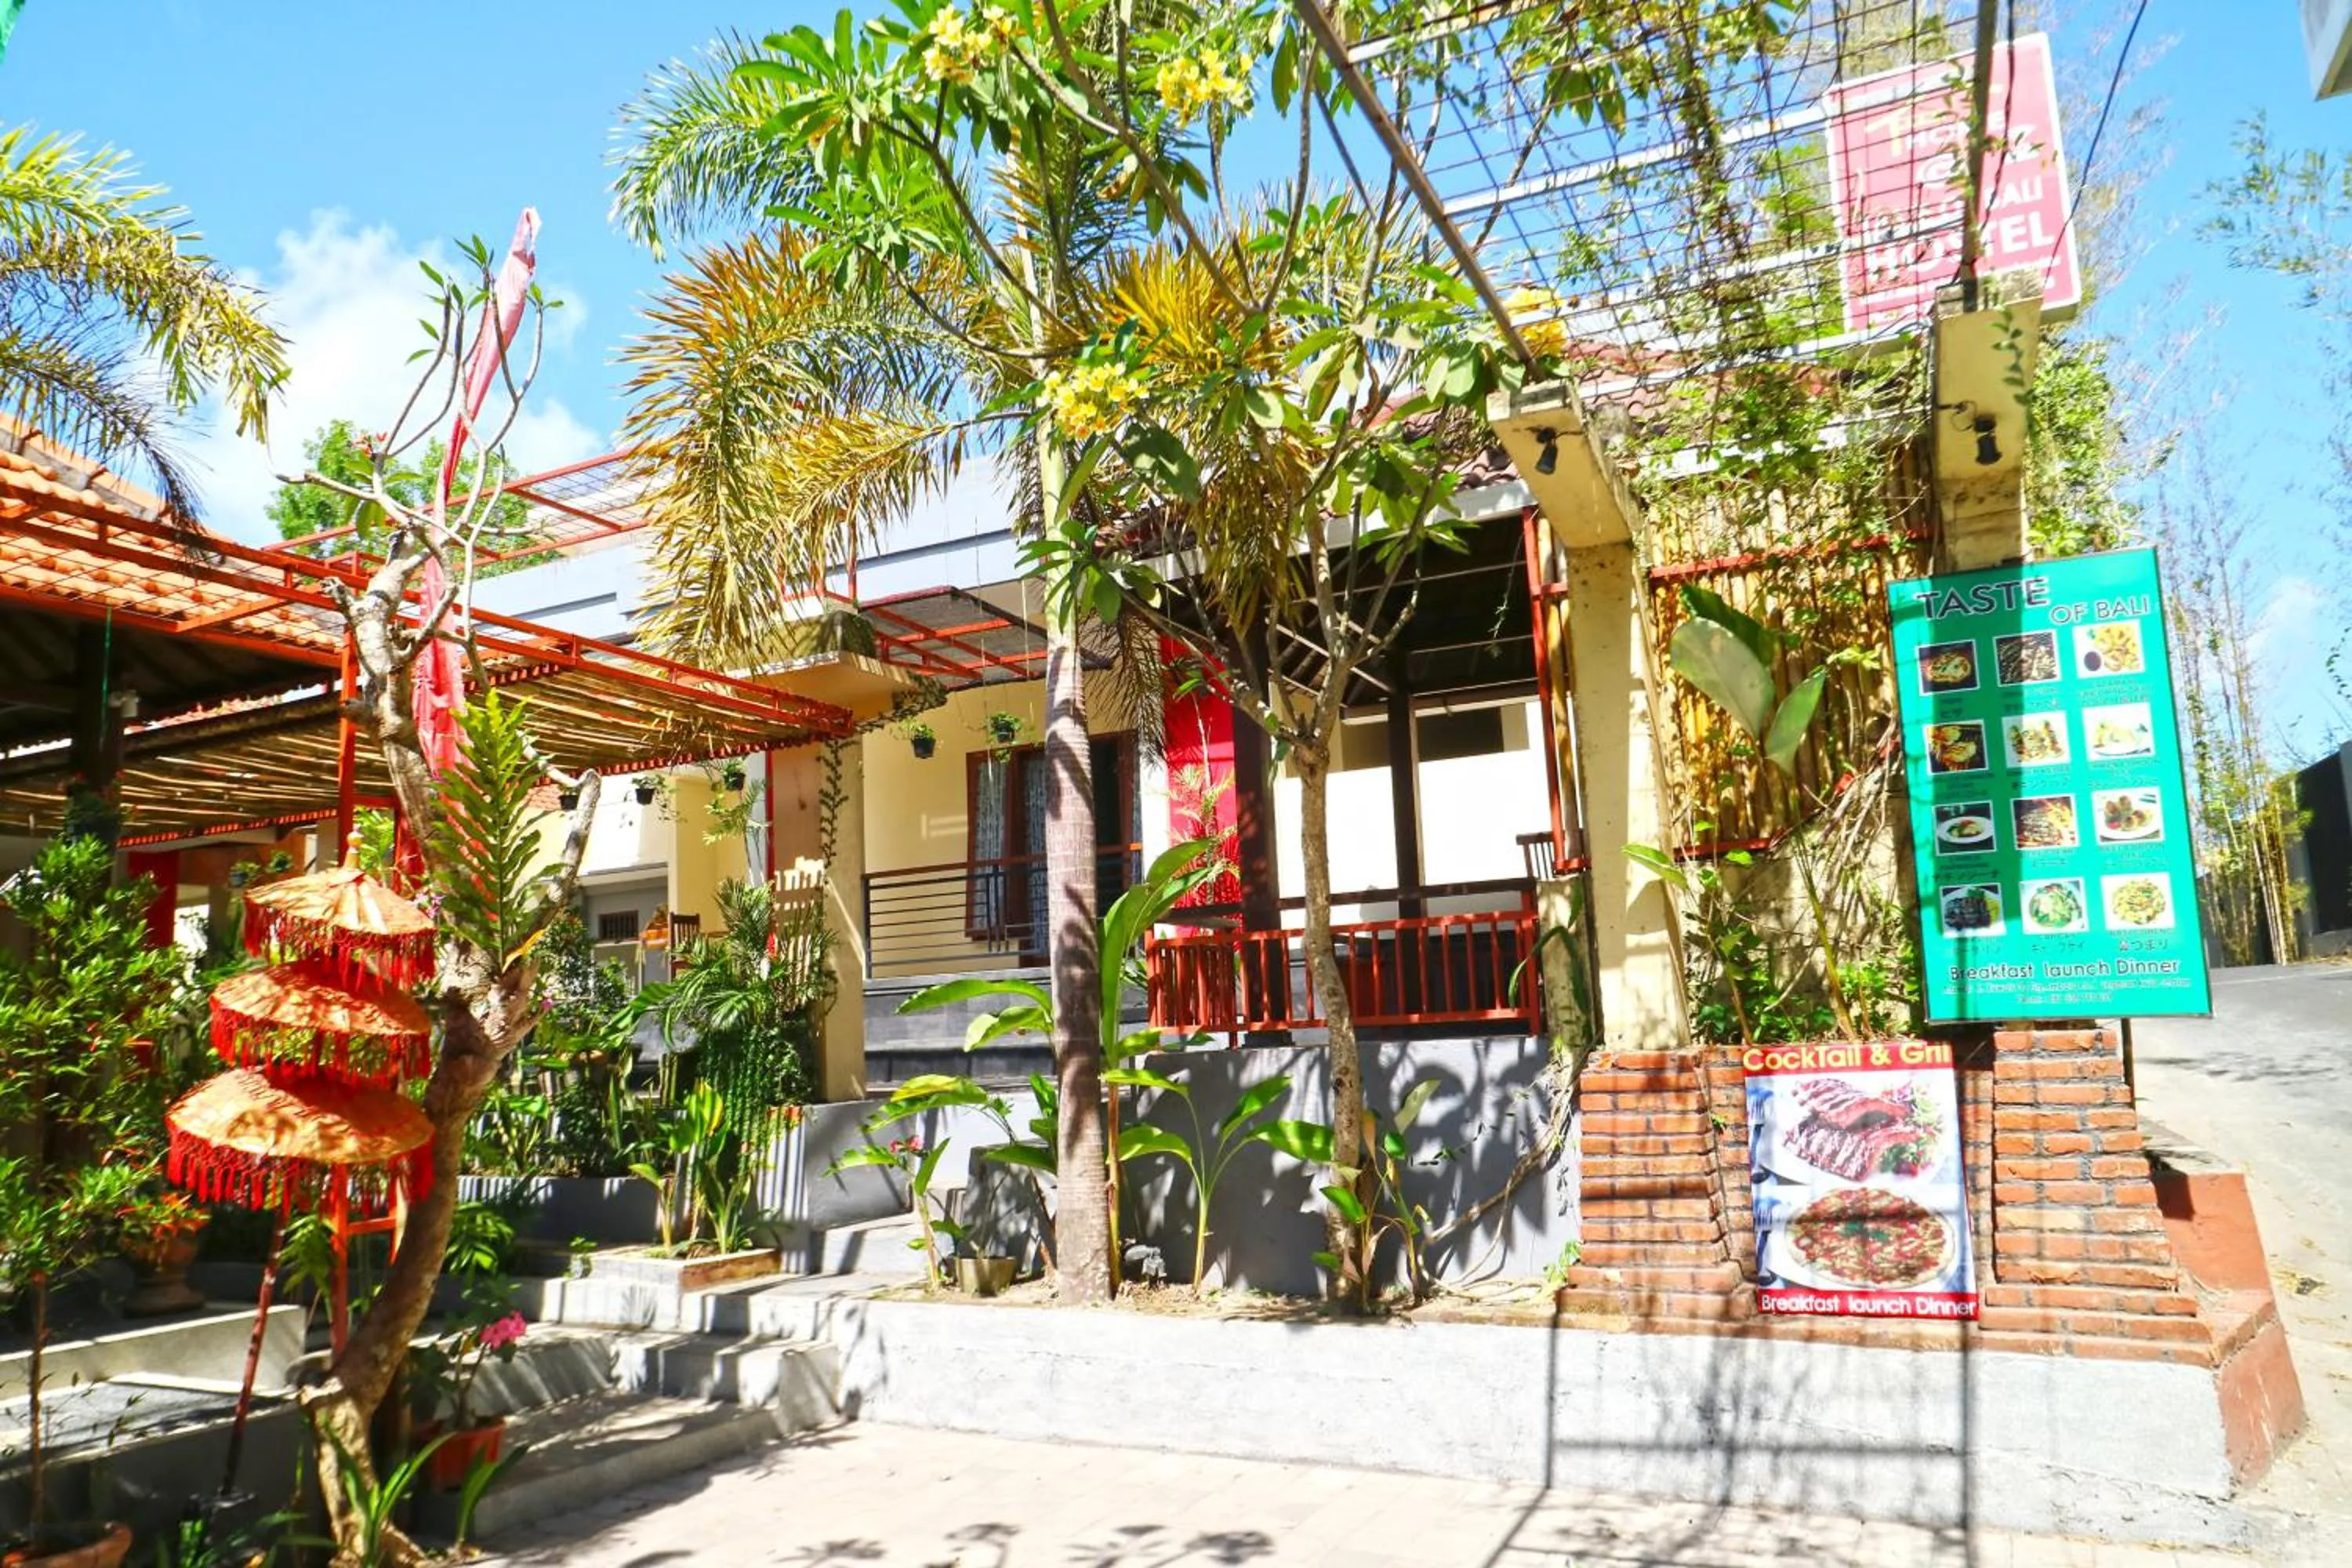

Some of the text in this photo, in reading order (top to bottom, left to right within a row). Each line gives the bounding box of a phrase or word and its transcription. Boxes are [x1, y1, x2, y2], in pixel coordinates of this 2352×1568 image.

[1915, 577, 2049, 620] TASTE
[2049, 596, 2150, 624] OF BALI
[1950, 958, 2180, 981] Breakfast launch Dinner
[1870, 1044, 1892, 1065] &
[1762, 1295, 1839, 1311] Breakfast
[1848, 1295, 1912, 1314] launch
